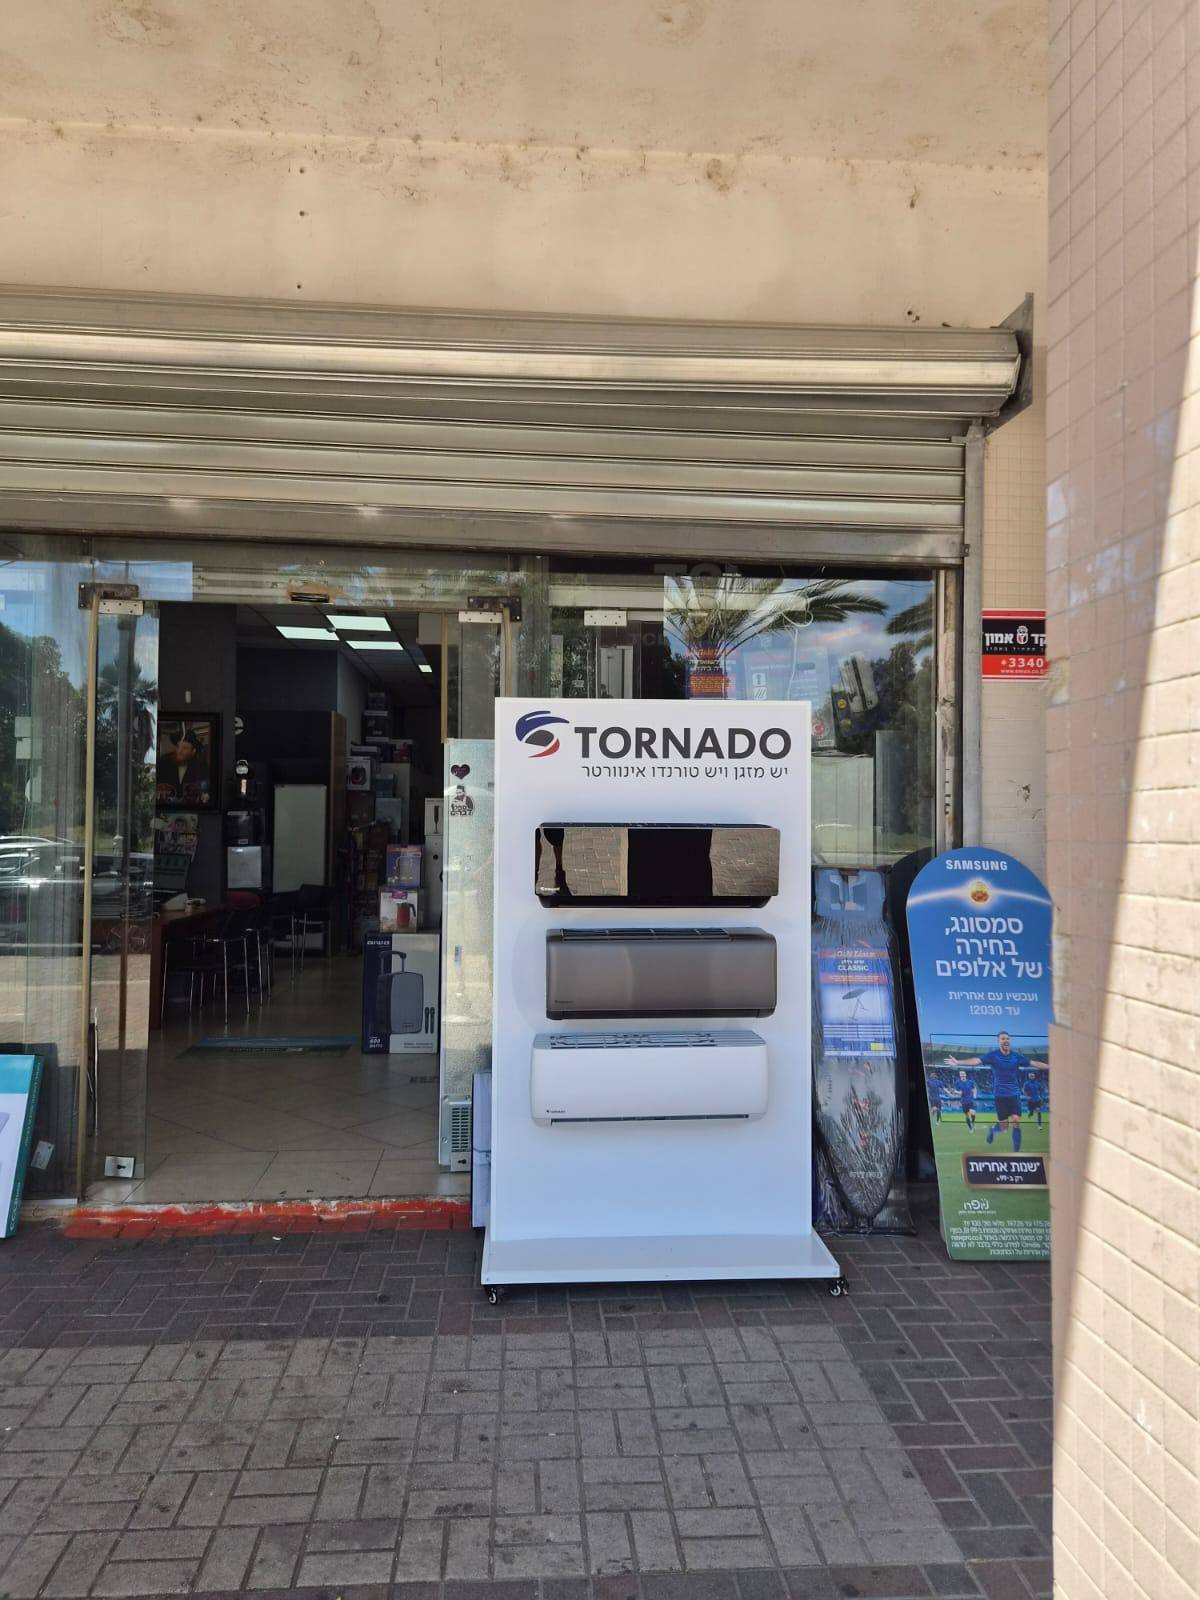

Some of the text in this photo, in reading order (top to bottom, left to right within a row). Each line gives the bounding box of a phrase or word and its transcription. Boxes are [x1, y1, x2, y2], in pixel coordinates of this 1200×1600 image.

[985, 632, 1014, 646] אמון
[574, 726, 792, 760] TORNADO
[582, 765, 788, 779] יש מזגן ויש טורנדו אינוורטר
[945, 859, 1008, 871] SAMSUNG
[945, 916, 1023, 935] סמסונג,
[956, 938, 1018, 956] בחירה
[936, 957, 1043, 979] של אלופים
[949, 991, 1038, 1002] ועכשיו עם אחריות
[969, 1005, 1020, 1016] עד 2030!
[968, 1161, 1008, 1172] אחריות
[1014, 1175, 1023, 1183] רק
